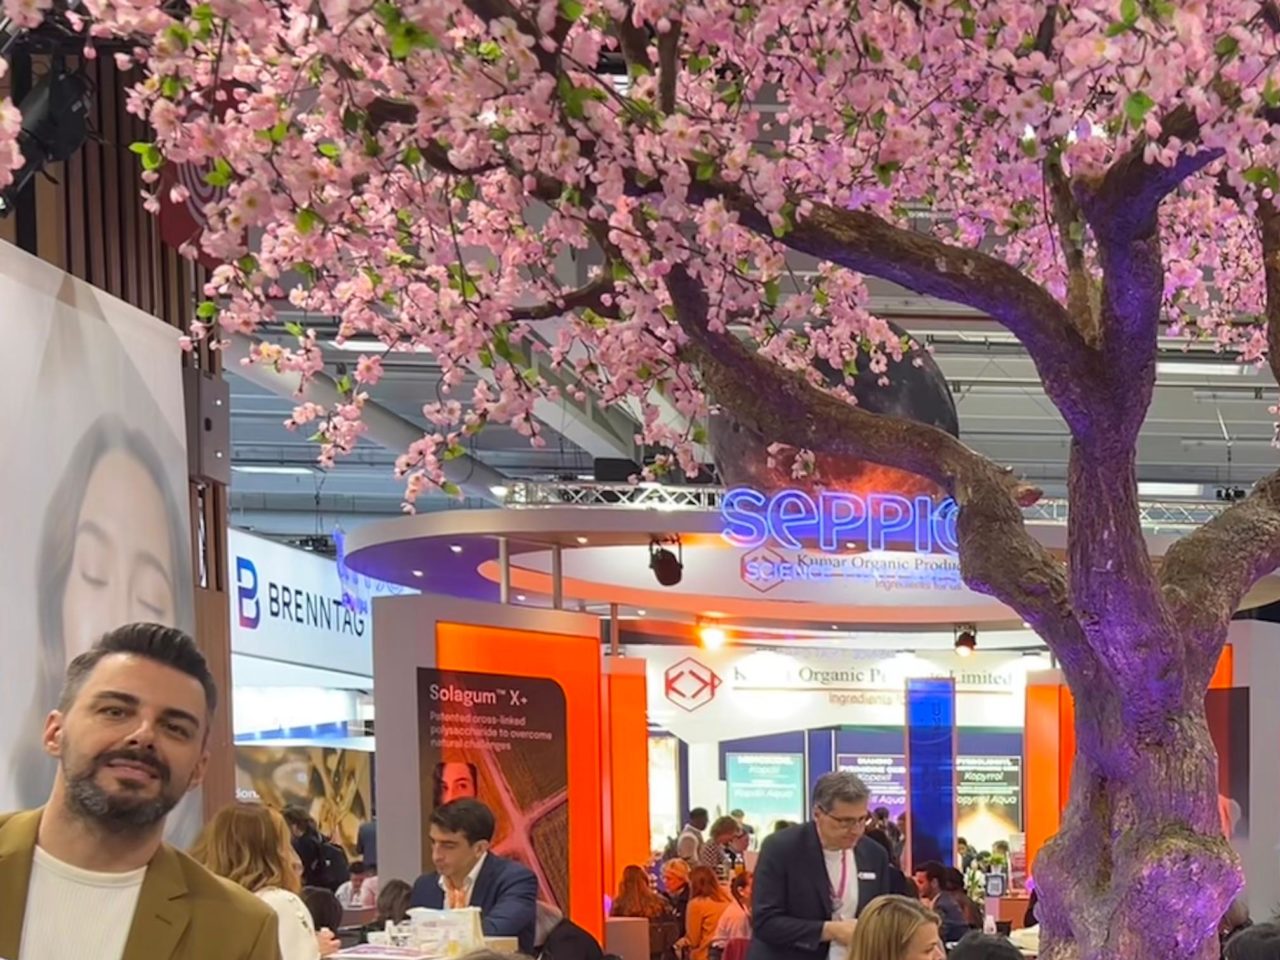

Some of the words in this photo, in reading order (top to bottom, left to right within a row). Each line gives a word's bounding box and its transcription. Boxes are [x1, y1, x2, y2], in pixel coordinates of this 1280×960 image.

[850, 555, 909, 571] Organic
[268, 581, 366, 638] BRENNTAG
[798, 666, 865, 686] Organic
[957, 668, 1013, 686] Limited
[510, 730, 553, 741] overcome
